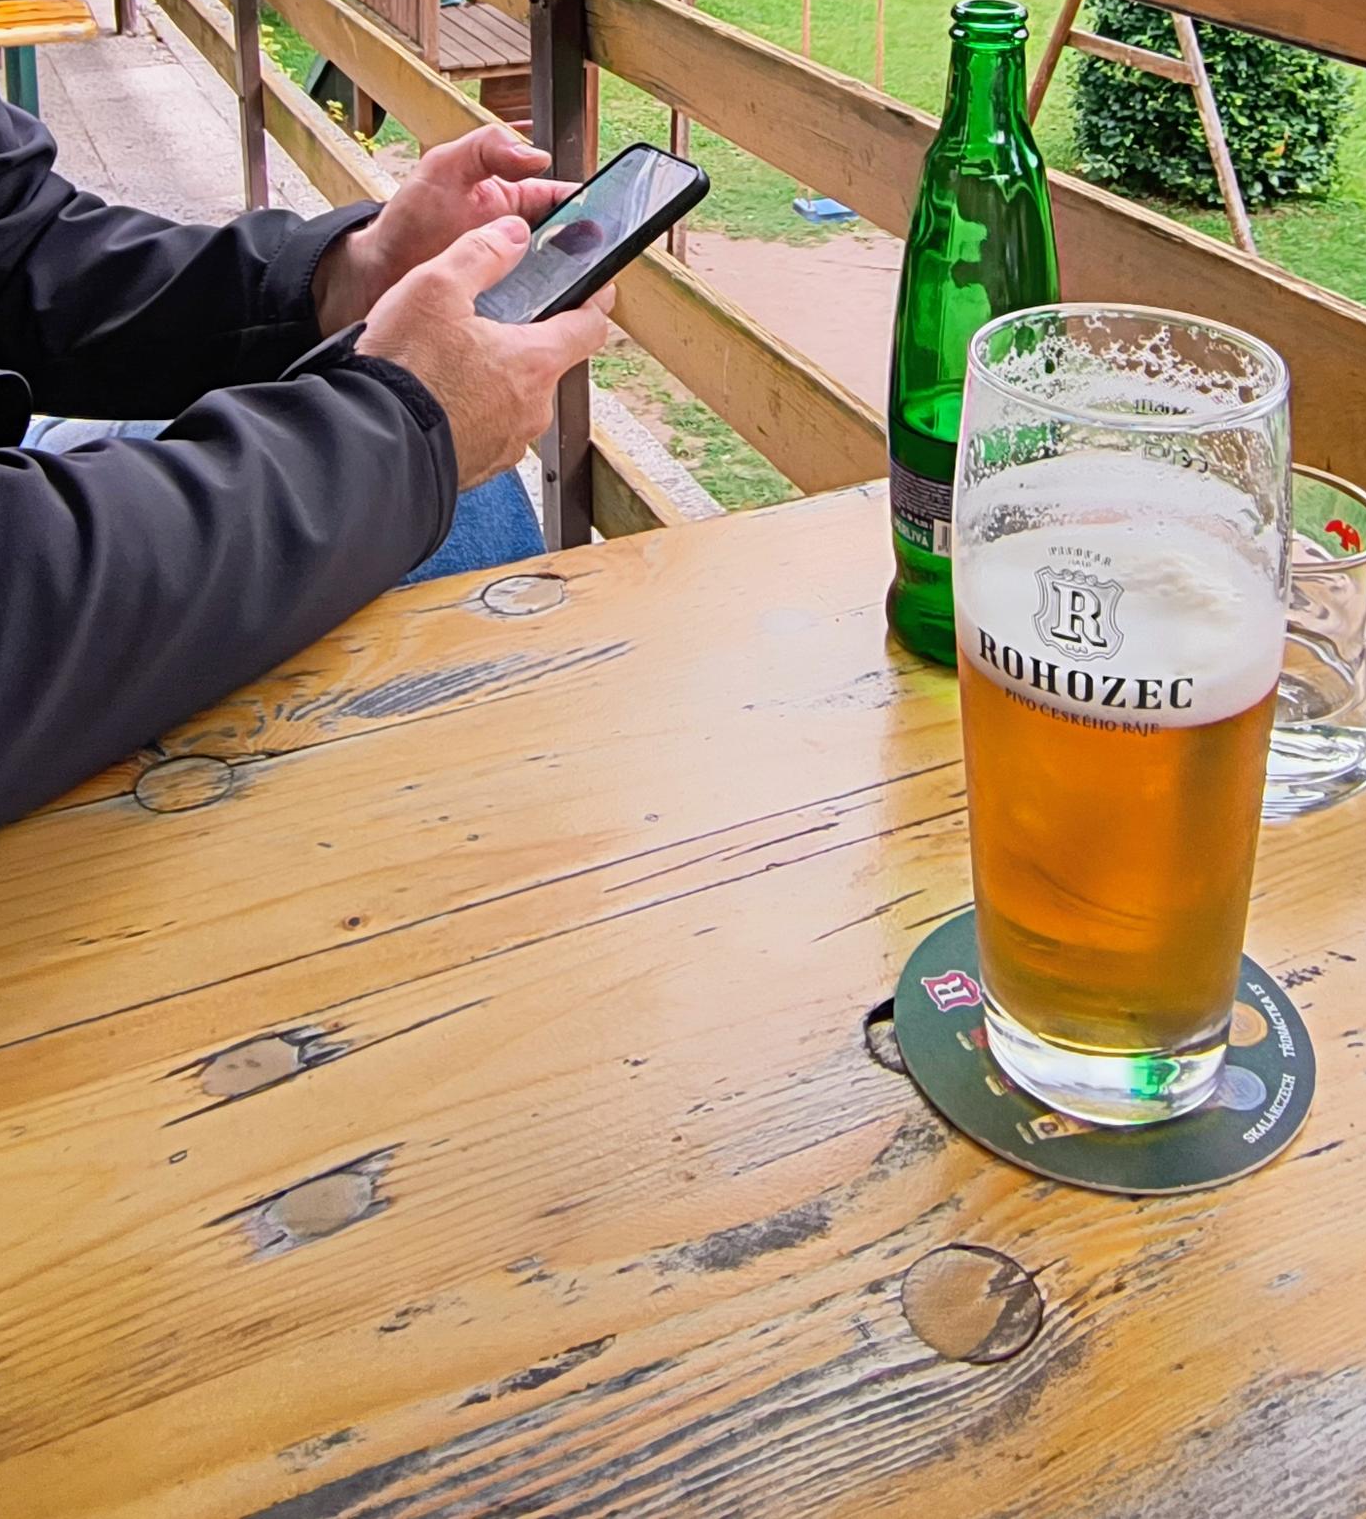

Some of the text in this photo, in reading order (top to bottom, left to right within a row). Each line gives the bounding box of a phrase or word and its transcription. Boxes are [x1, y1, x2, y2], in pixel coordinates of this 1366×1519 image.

[1047, 545, 1113, 567] PIVOVAR
[1049, 581, 1108, 648] R
[977, 626, 1194, 710] ROHOZEC
[1005, 687, 1160, 738] PIVO ČESKÉHO RÁJE
